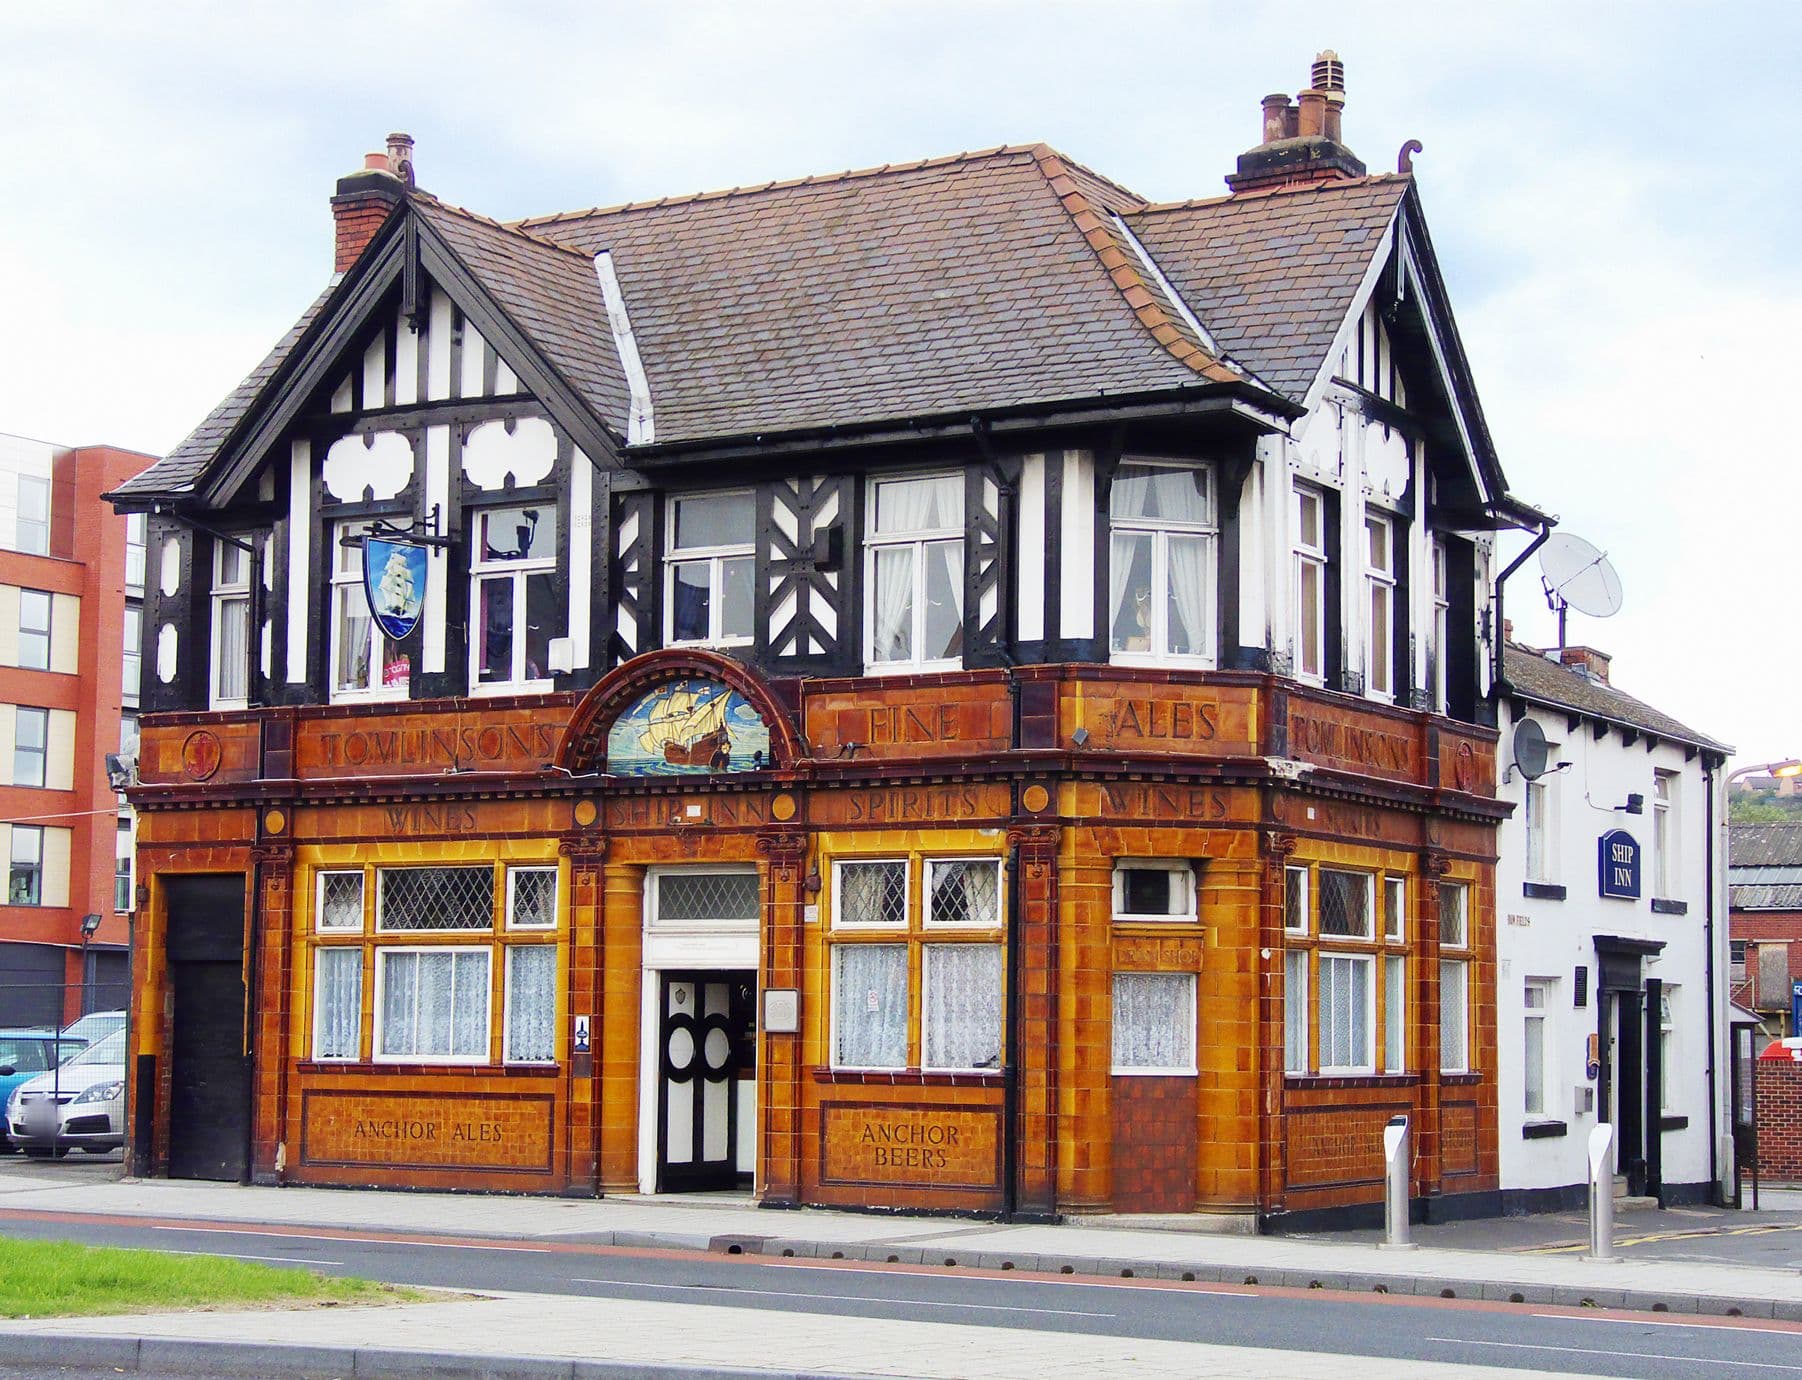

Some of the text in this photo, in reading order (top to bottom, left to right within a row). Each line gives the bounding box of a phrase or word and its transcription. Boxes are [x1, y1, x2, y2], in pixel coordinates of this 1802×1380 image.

[871, 703, 960, 743] FINE
[1116, 700, 1217, 740] ALES
[613, 796, 765, 826] SHIP INN
[850, 785, 977, 820] SPIRITS
[1101, 785, 1227, 818] WINES
[386, 804, 476, 833] WINES
[1612, 843, 1634, 864] SHIP
[1614, 867, 1632, 888] INN
[354, 1120, 502, 1142] ANCHOR ALES
[861, 1123, 960, 1145] ANCHOR
[875, 1147, 947, 1169] BEERS
